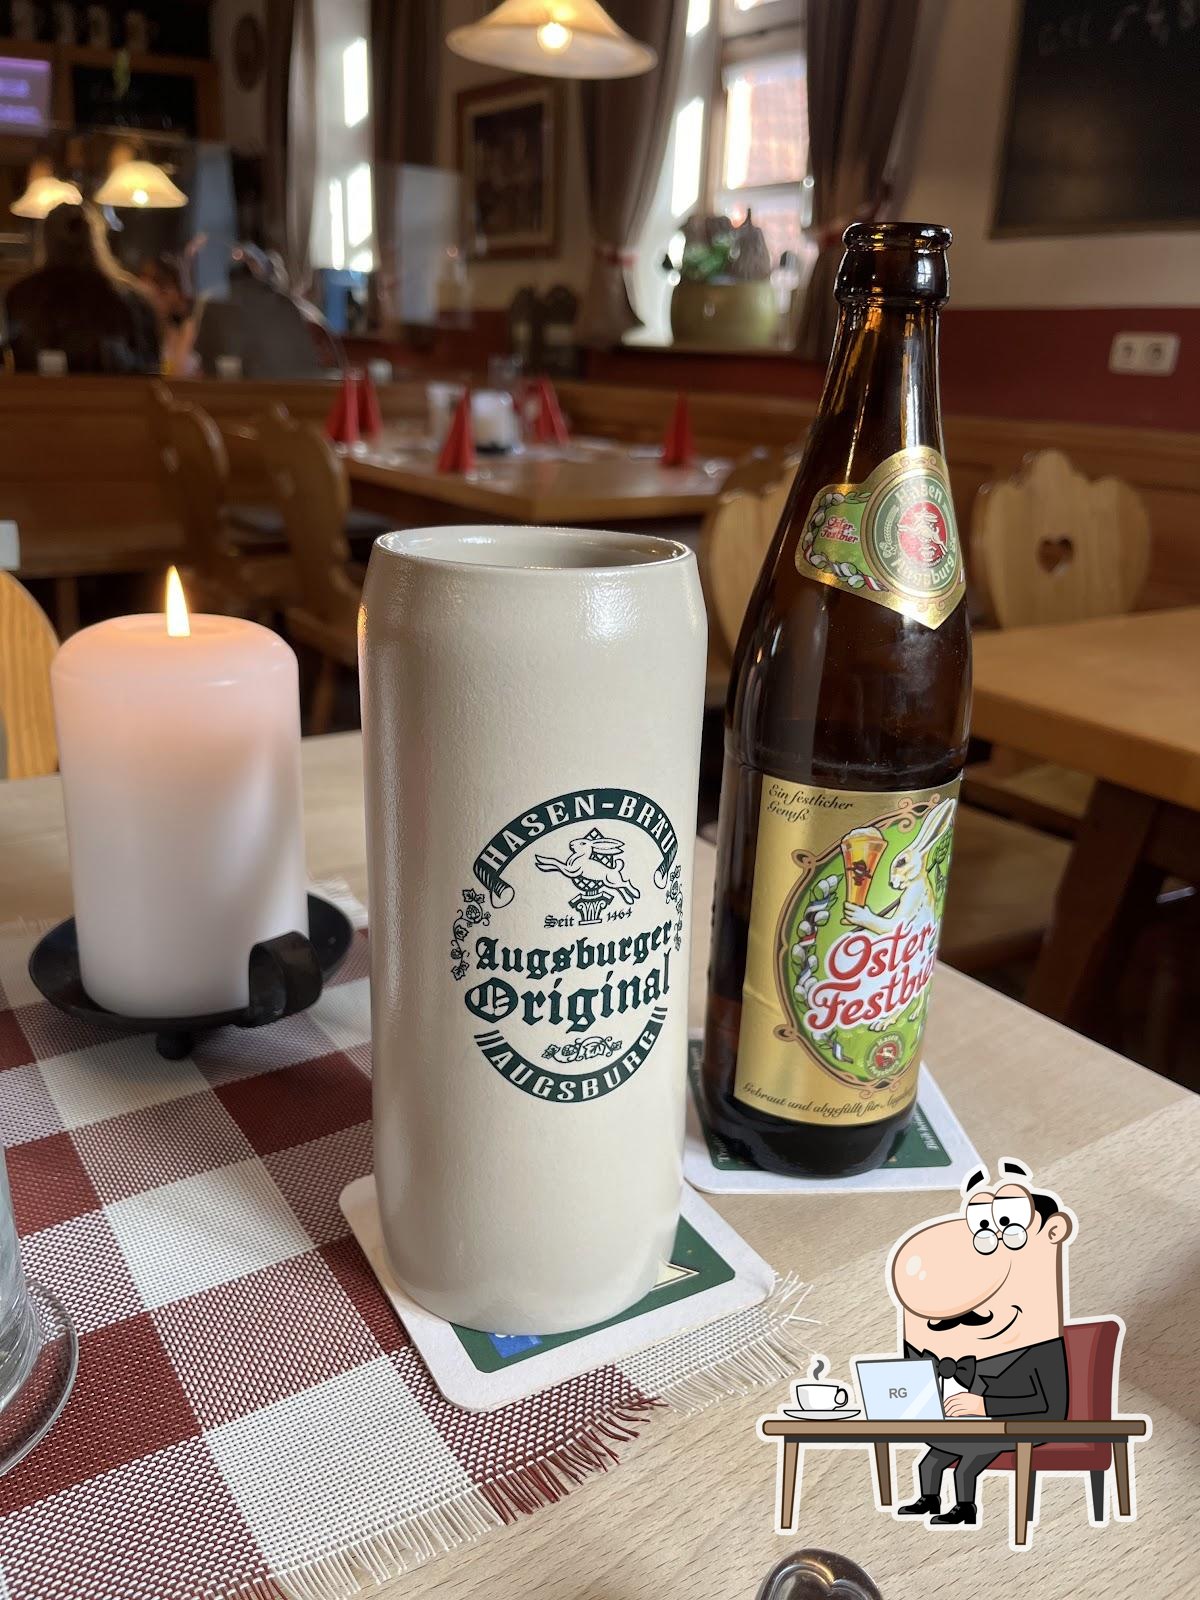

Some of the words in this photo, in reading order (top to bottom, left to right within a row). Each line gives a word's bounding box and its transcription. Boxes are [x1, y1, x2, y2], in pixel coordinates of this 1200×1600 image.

[767, 800, 809, 823] Genuß
[769, 784, 789, 804] Ein
[788, 790, 854, 810] festlicher
[480, 793, 677, 871] HASEN-BRÄU
[543, 914, 575, 929] Seit
[606, 906, 633, 922] 1464
[475, 919, 673, 980] Augsburger
[464, 948, 671, 1034] Original
[489, 1030, 657, 1100] AUGSBURG
[743, 1082, 787, 1106] Gebraut
[787, 1101, 813, 1112] und
[812, 1102, 862, 1118] abgefüllt
